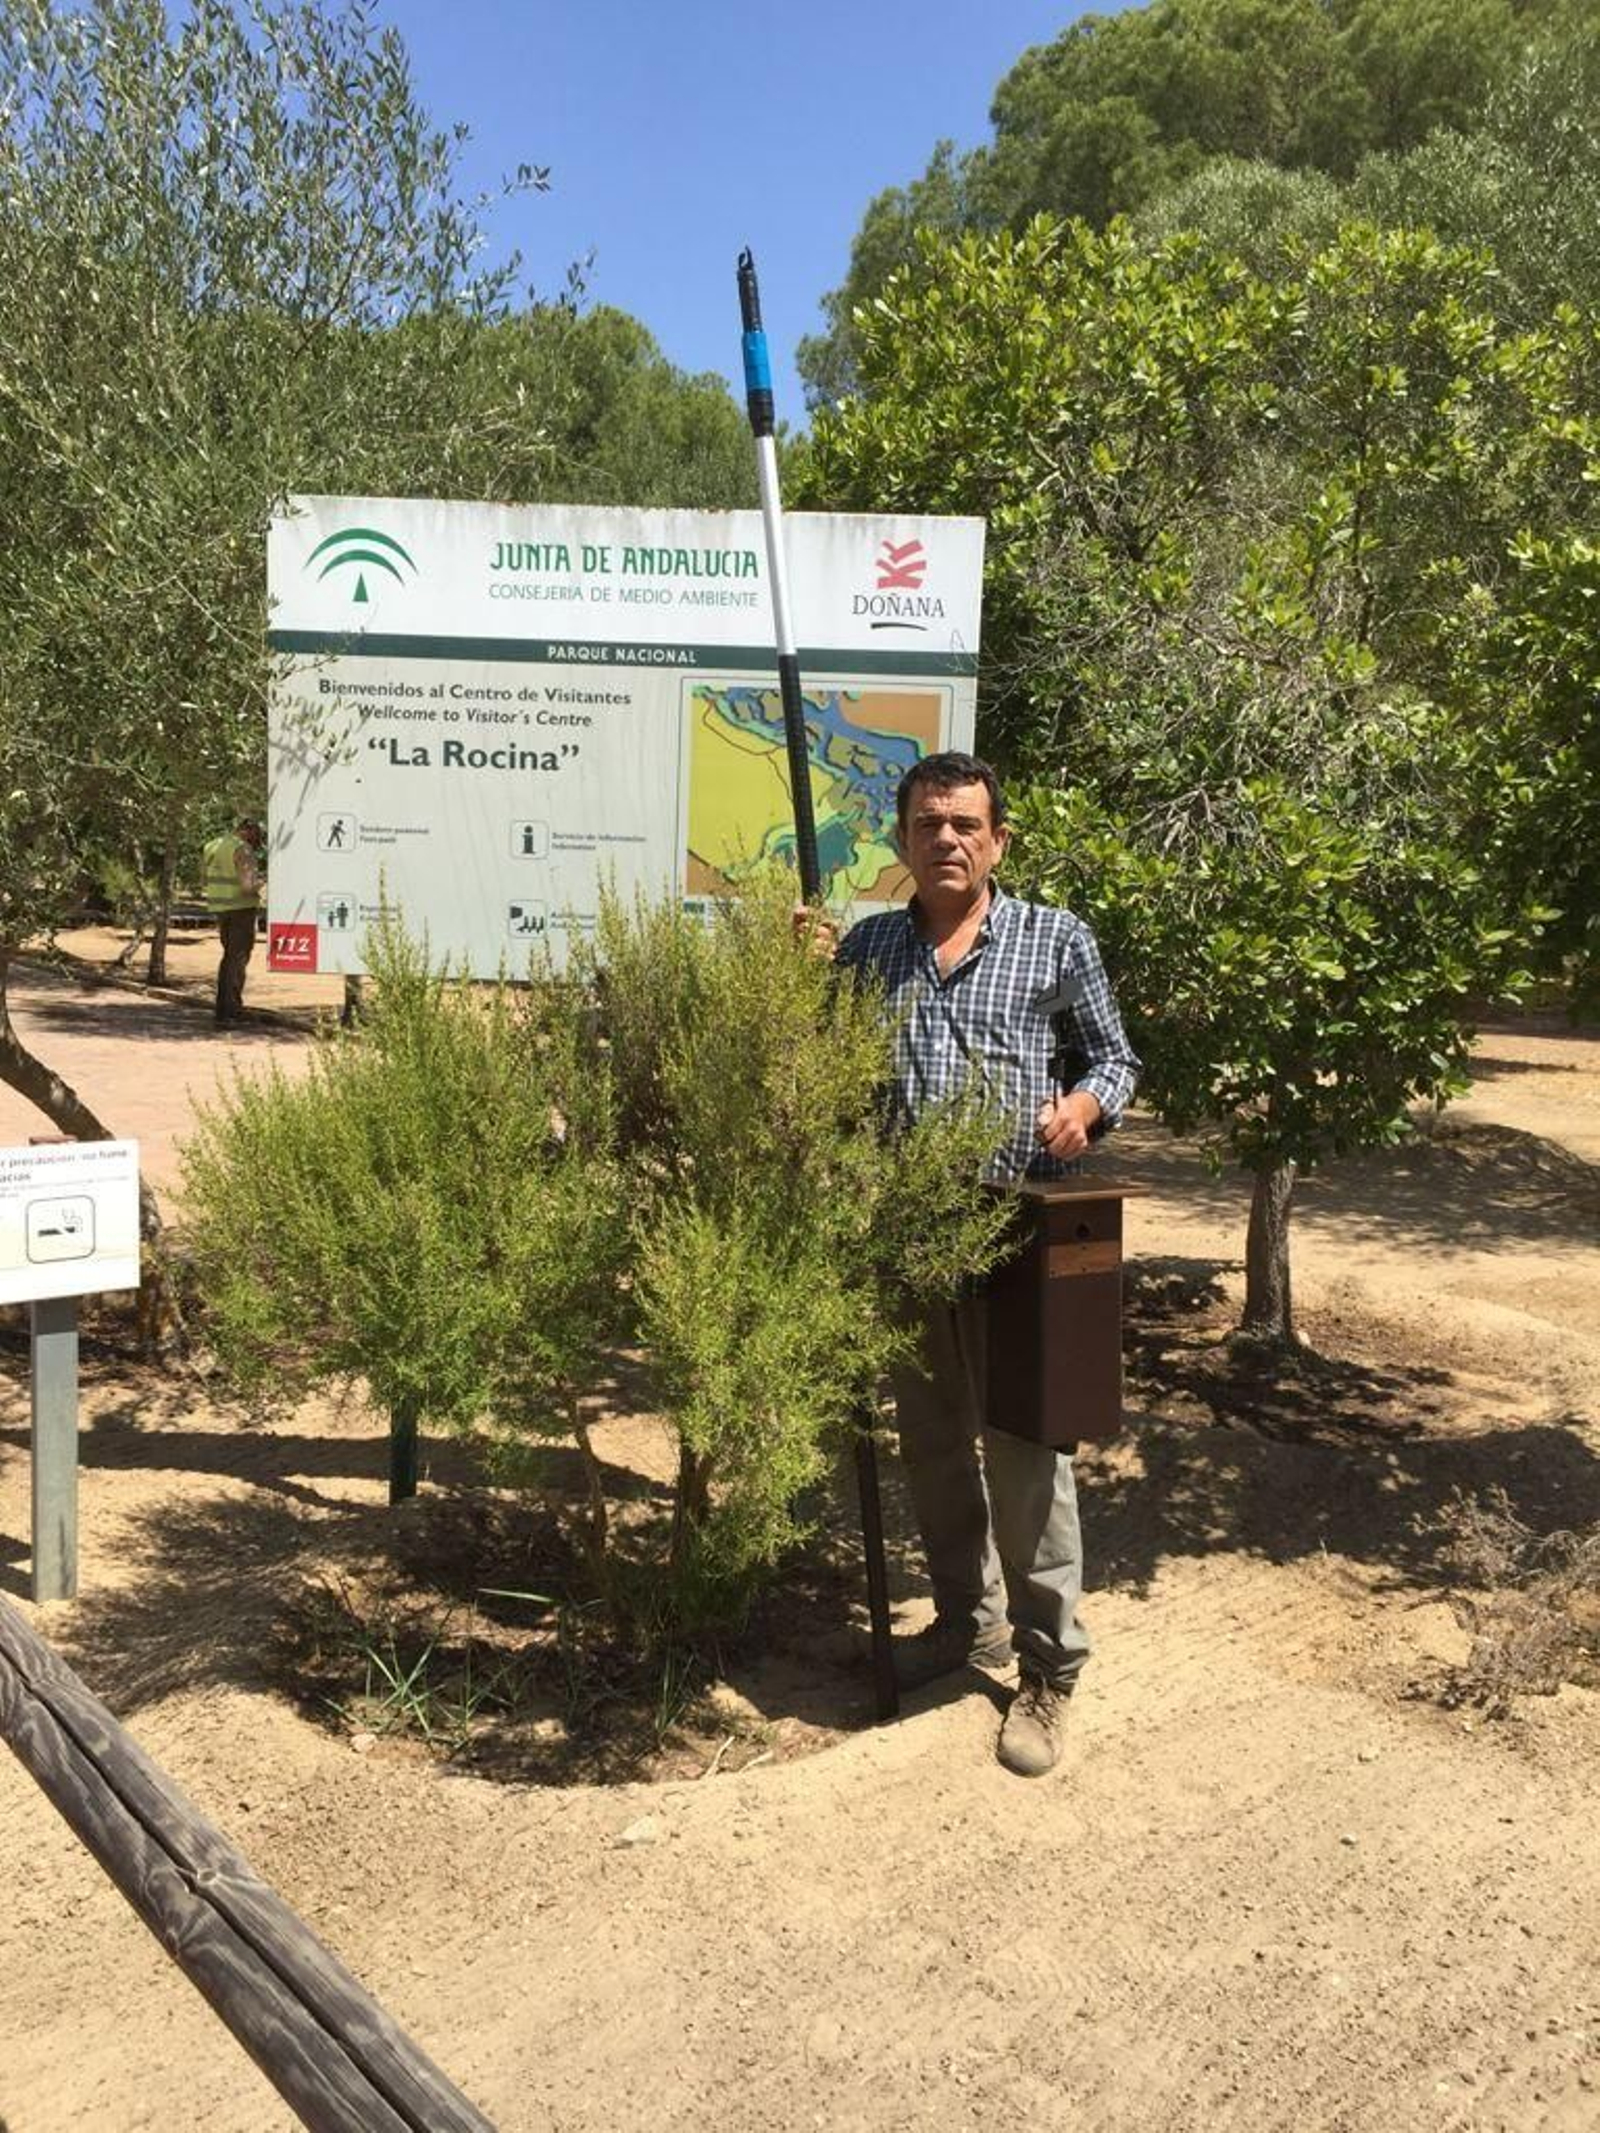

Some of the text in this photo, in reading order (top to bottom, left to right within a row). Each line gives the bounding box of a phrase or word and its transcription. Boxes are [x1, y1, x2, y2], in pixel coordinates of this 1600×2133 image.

[490, 543, 759, 578] JUNTA DE ANDALUCIA
[591, 587, 612, 603] DE
[620, 588, 672, 605] MEDIO
[680, 590, 759, 608] AMBIENTE
[852, 592, 945, 618] DOÑANA
[548, 646, 697, 665] PARQUE NACIONAL
[319, 679, 632, 705] Bienvenidos al Centro de Visitantes
[358, 704, 436, 721] Wellcome
[443, 708, 460, 722] to
[536, 711, 592, 727] Centre
[275, 936, 311, 953] 112
